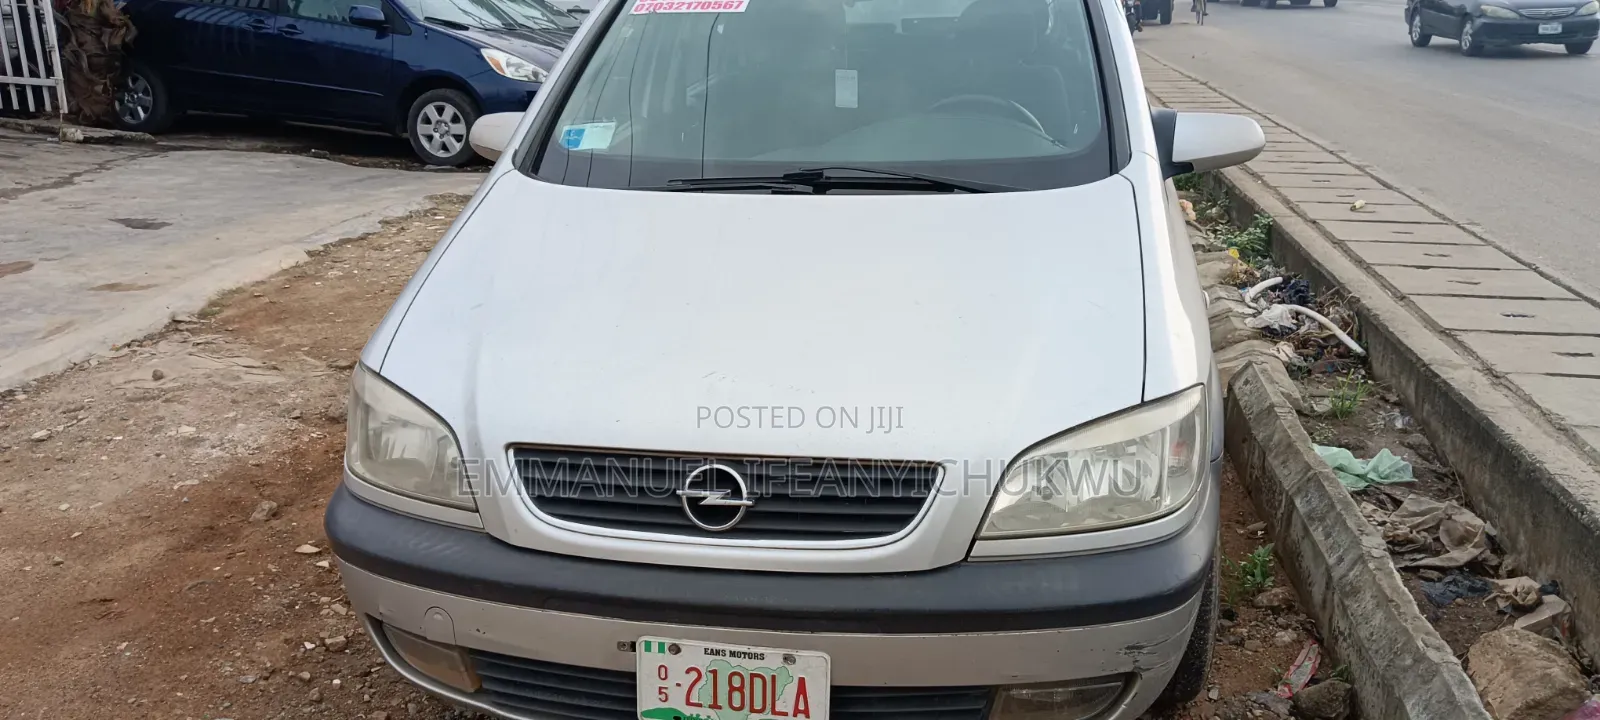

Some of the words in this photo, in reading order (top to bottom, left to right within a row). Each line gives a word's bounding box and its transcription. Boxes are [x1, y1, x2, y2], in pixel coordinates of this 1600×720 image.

[634, 0, 743, 12] 07032170567
[703, 647, 727, 658] EANS
[728, 649, 765, 661] MOTORS
